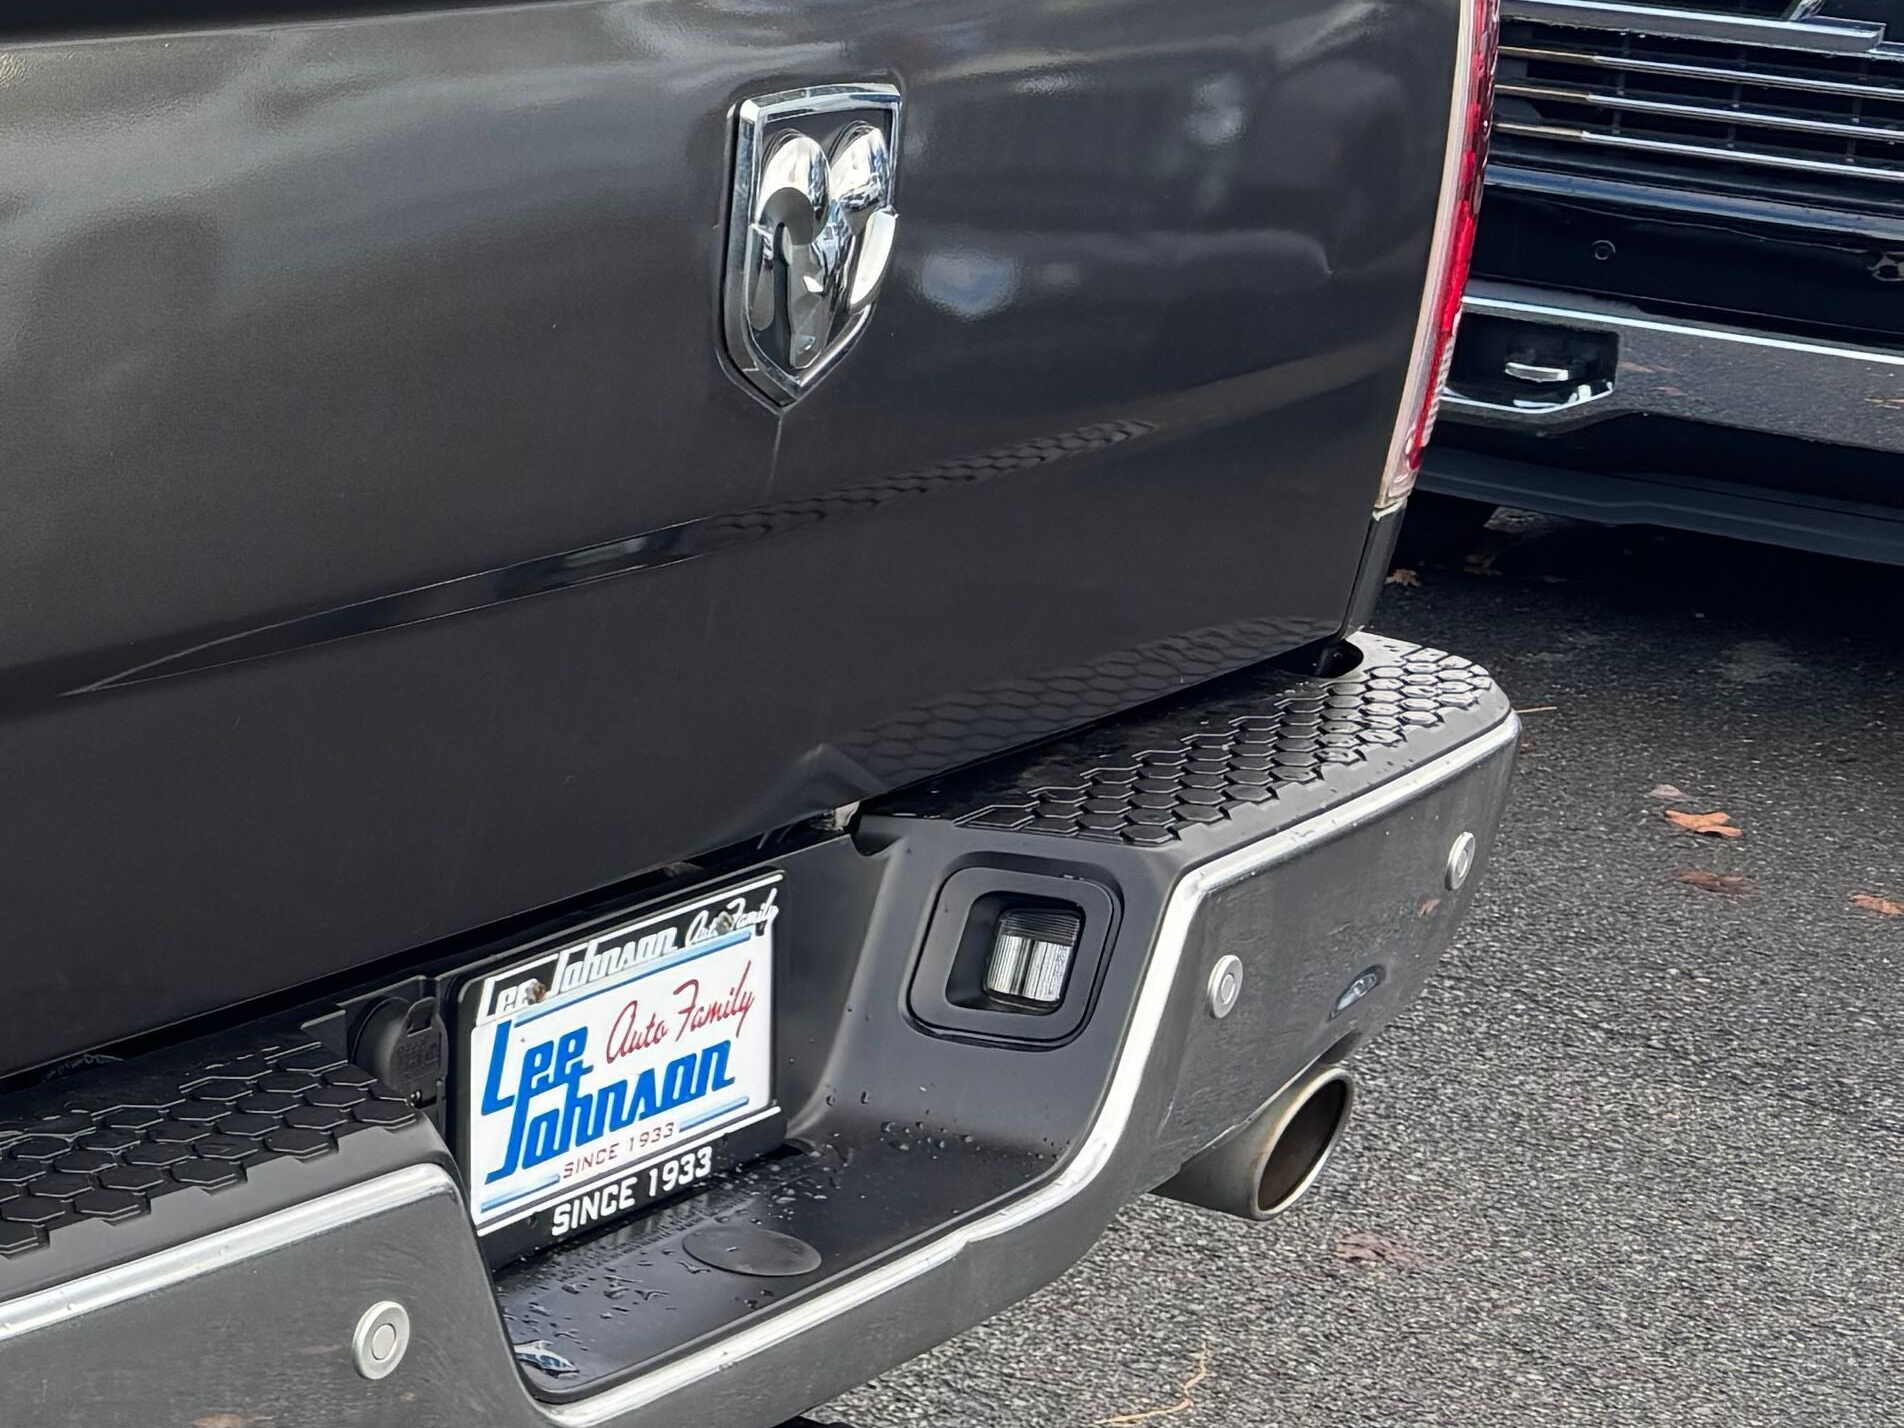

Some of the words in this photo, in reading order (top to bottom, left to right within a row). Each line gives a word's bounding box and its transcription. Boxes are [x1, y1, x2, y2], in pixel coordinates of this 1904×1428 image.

[544, 926, 678, 998] Johnson
[605, 999, 668, 1064] Auto
[672, 959, 755, 1042] Family
[481, 1019, 594, 1116] Lee
[484, 1039, 736, 1185] Johnson
[551, 1176, 639, 1237] SINCE
[647, 1145, 714, 1197] 1933
[562, 1142, 620, 1180] SINCE
[628, 1122, 675, 1152] 1933
